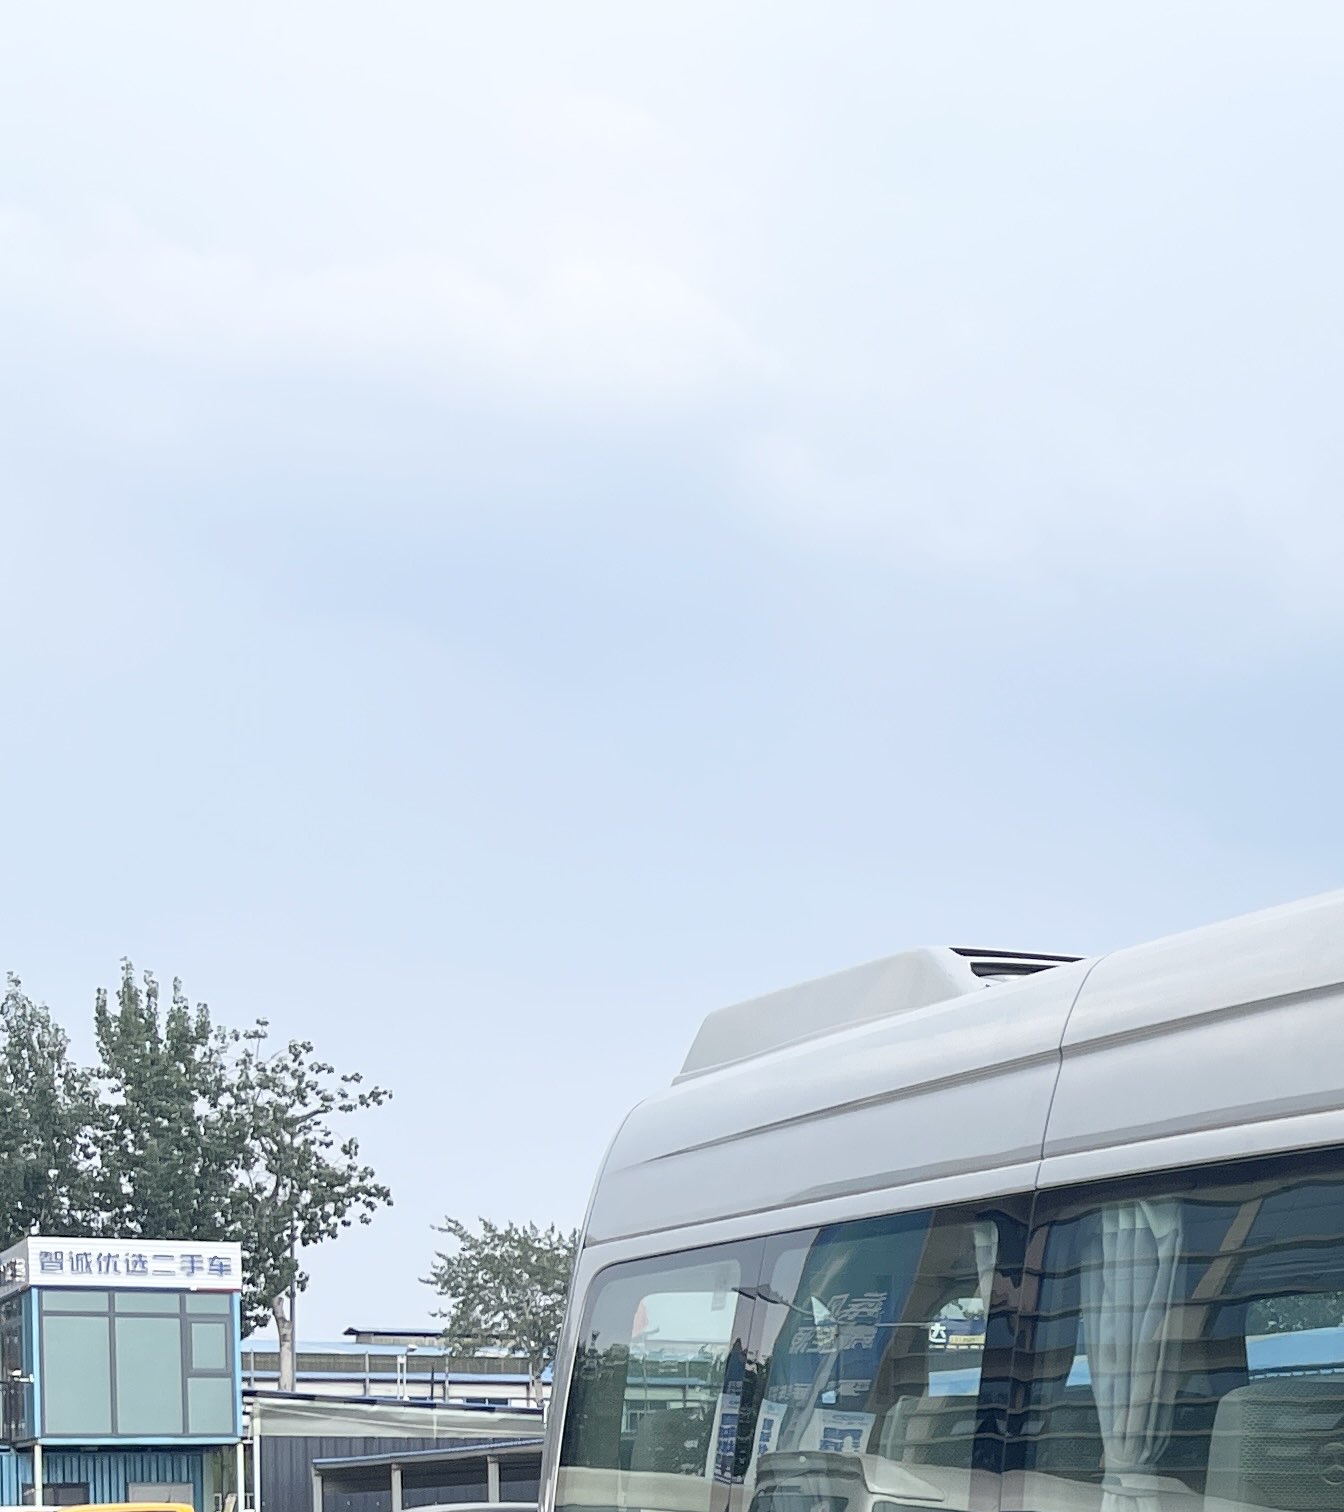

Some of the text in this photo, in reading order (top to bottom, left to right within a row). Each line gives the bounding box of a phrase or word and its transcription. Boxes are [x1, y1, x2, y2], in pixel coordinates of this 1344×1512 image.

[40, 1251, 232, 1277] 智诚优选二手车
